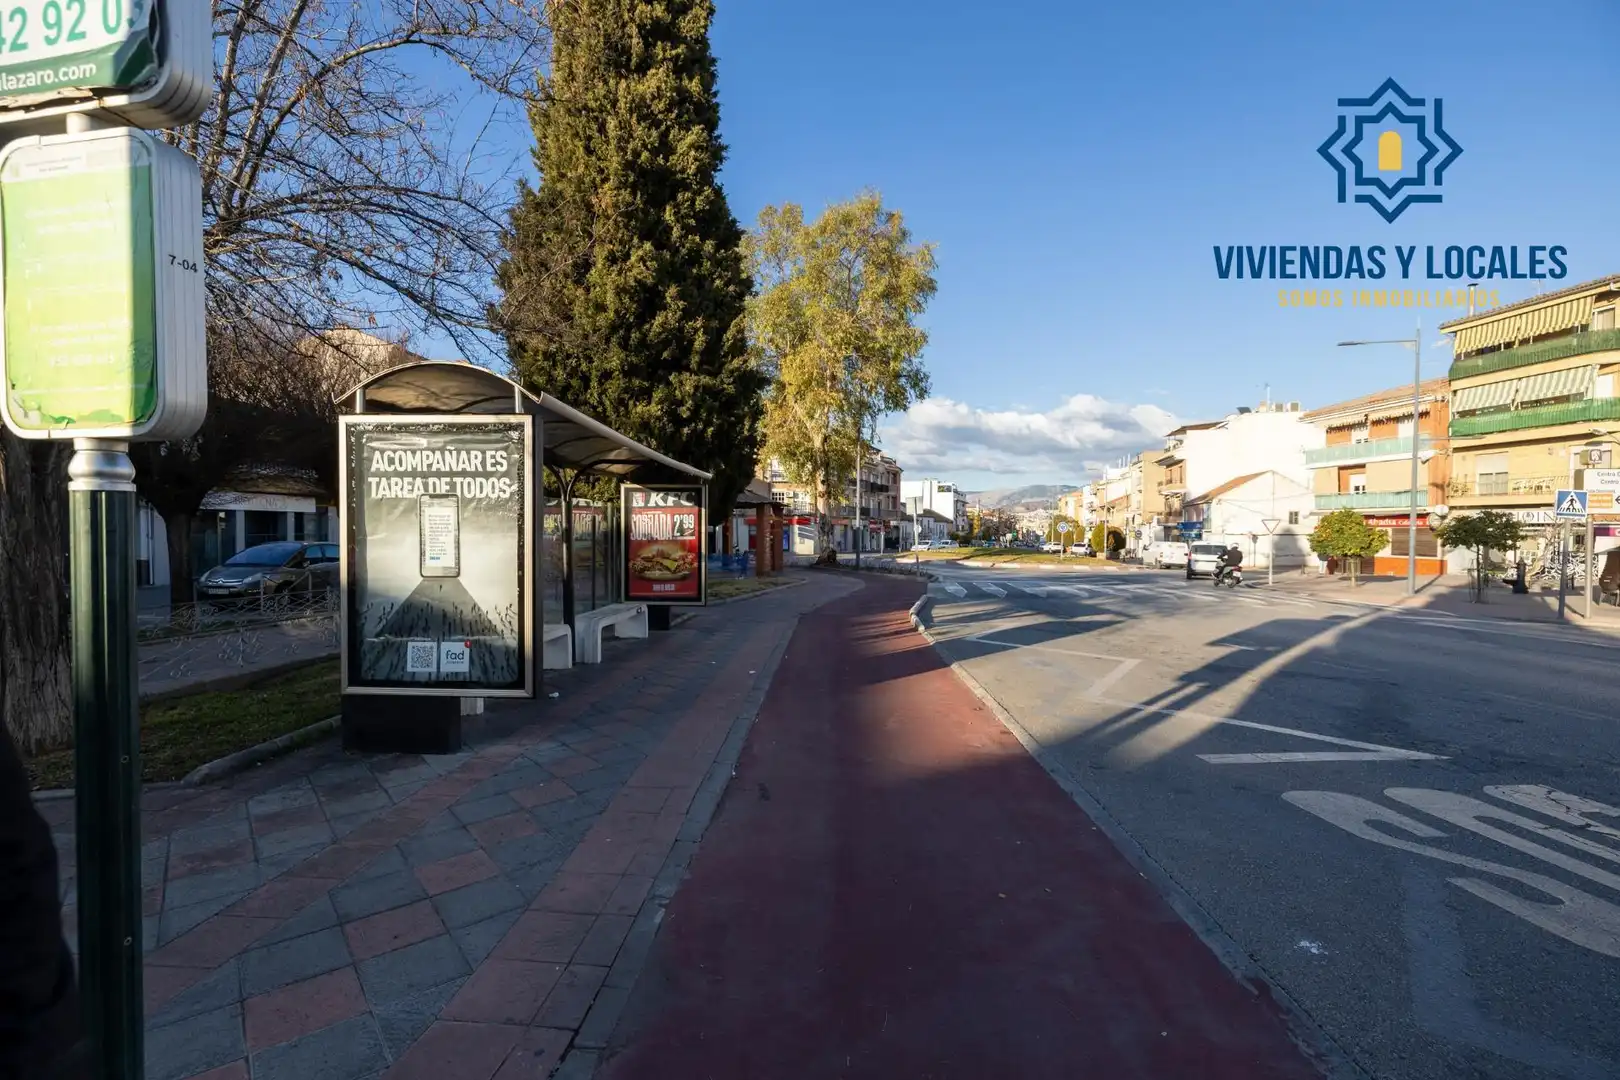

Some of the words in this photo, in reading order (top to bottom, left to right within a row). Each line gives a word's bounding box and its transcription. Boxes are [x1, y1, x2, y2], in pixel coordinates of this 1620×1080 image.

[0, 6, 28, 53] 2
[42, 0, 87, 46] 92
[0, 63, 96, 91] lazaro.com
[168, 253, 198, 273] 7-04
[370, 445, 483, 472] ACOMPAÑAR
[486, 450, 508, 472] ES
[368, 476, 425, 499] TAREA
[428, 476, 450, 494] DE
[453, 476, 512, 499] TODOS
[647, 491, 695, 507] KFC
[445, 649, 465, 660] fad
